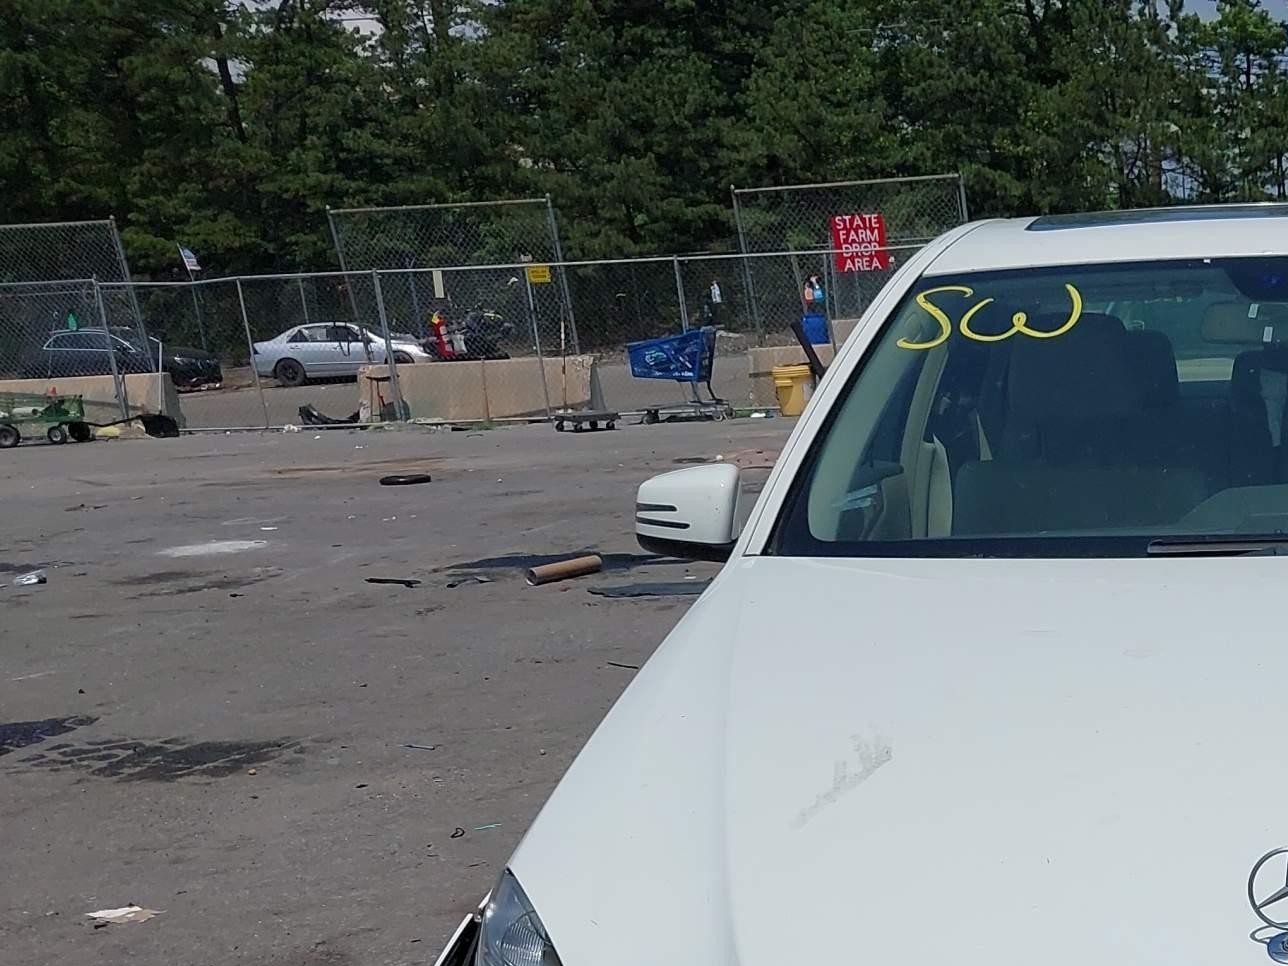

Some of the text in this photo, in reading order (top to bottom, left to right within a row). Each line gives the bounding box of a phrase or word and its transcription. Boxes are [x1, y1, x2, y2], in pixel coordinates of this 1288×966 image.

[835, 214, 880, 230] STATE
[839, 228, 880, 244] FARM
[842, 242, 880, 257] DROP
[844, 256, 882, 272] AREA
